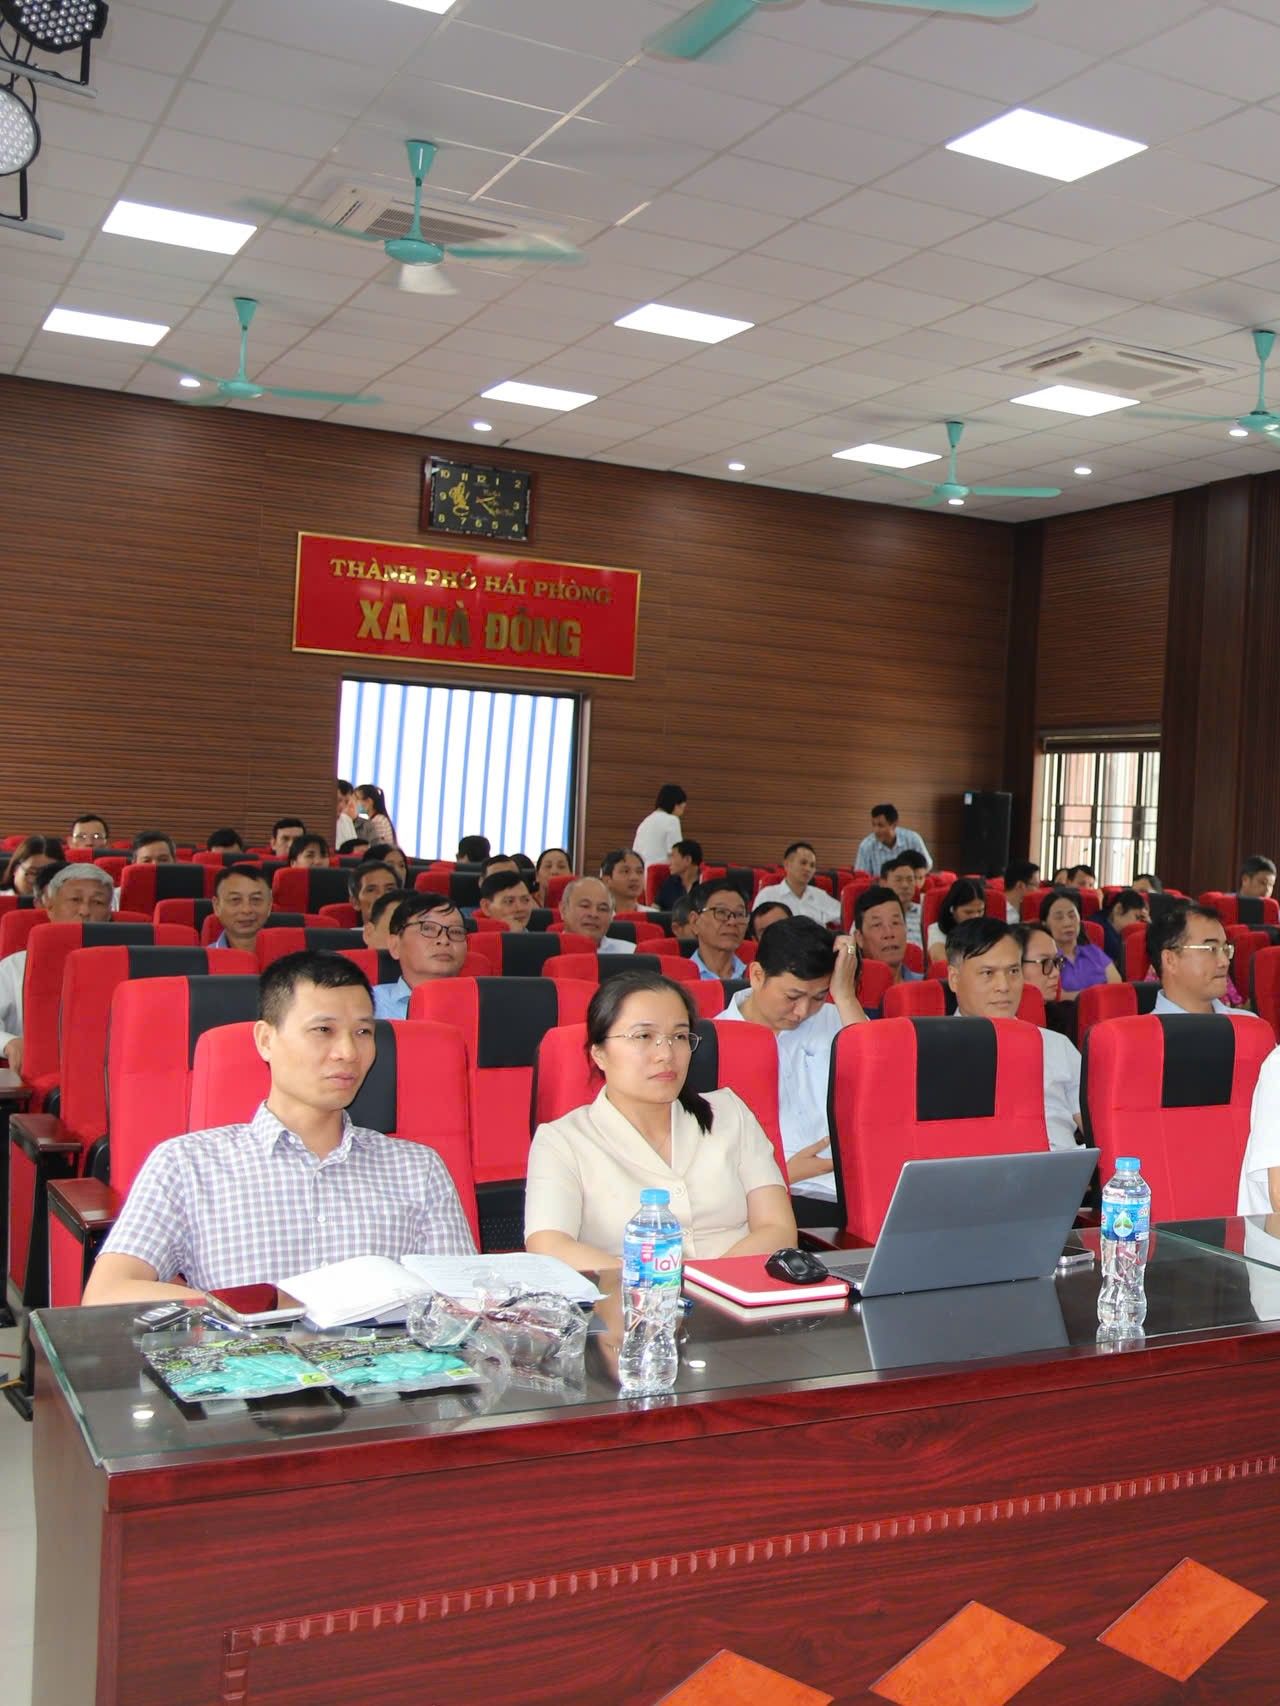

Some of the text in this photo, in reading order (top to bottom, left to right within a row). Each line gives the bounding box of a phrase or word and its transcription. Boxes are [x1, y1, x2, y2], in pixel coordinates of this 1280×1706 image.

[440, 469, 450, 479] 10
[461, 472, 469, 481] 11
[477, 475, 487, 483] 12
[514, 479, 521, 488] 2
[440, 491, 447, 501] 9
[513, 501, 520, 510] 3
[438, 513, 446, 523] 8
[461, 517, 467, 525] 7
[475, 519, 482, 528] 6
[492, 521, 498, 530] 5
[512, 523, 519, 532] 4
[330, 557, 417, 585] THÀNH
[484, 573, 527, 595] HẢI
[533, 579, 610, 605] PHÒNG
[356, 595, 581, 657] XÃ HÀ ĐÔNG
